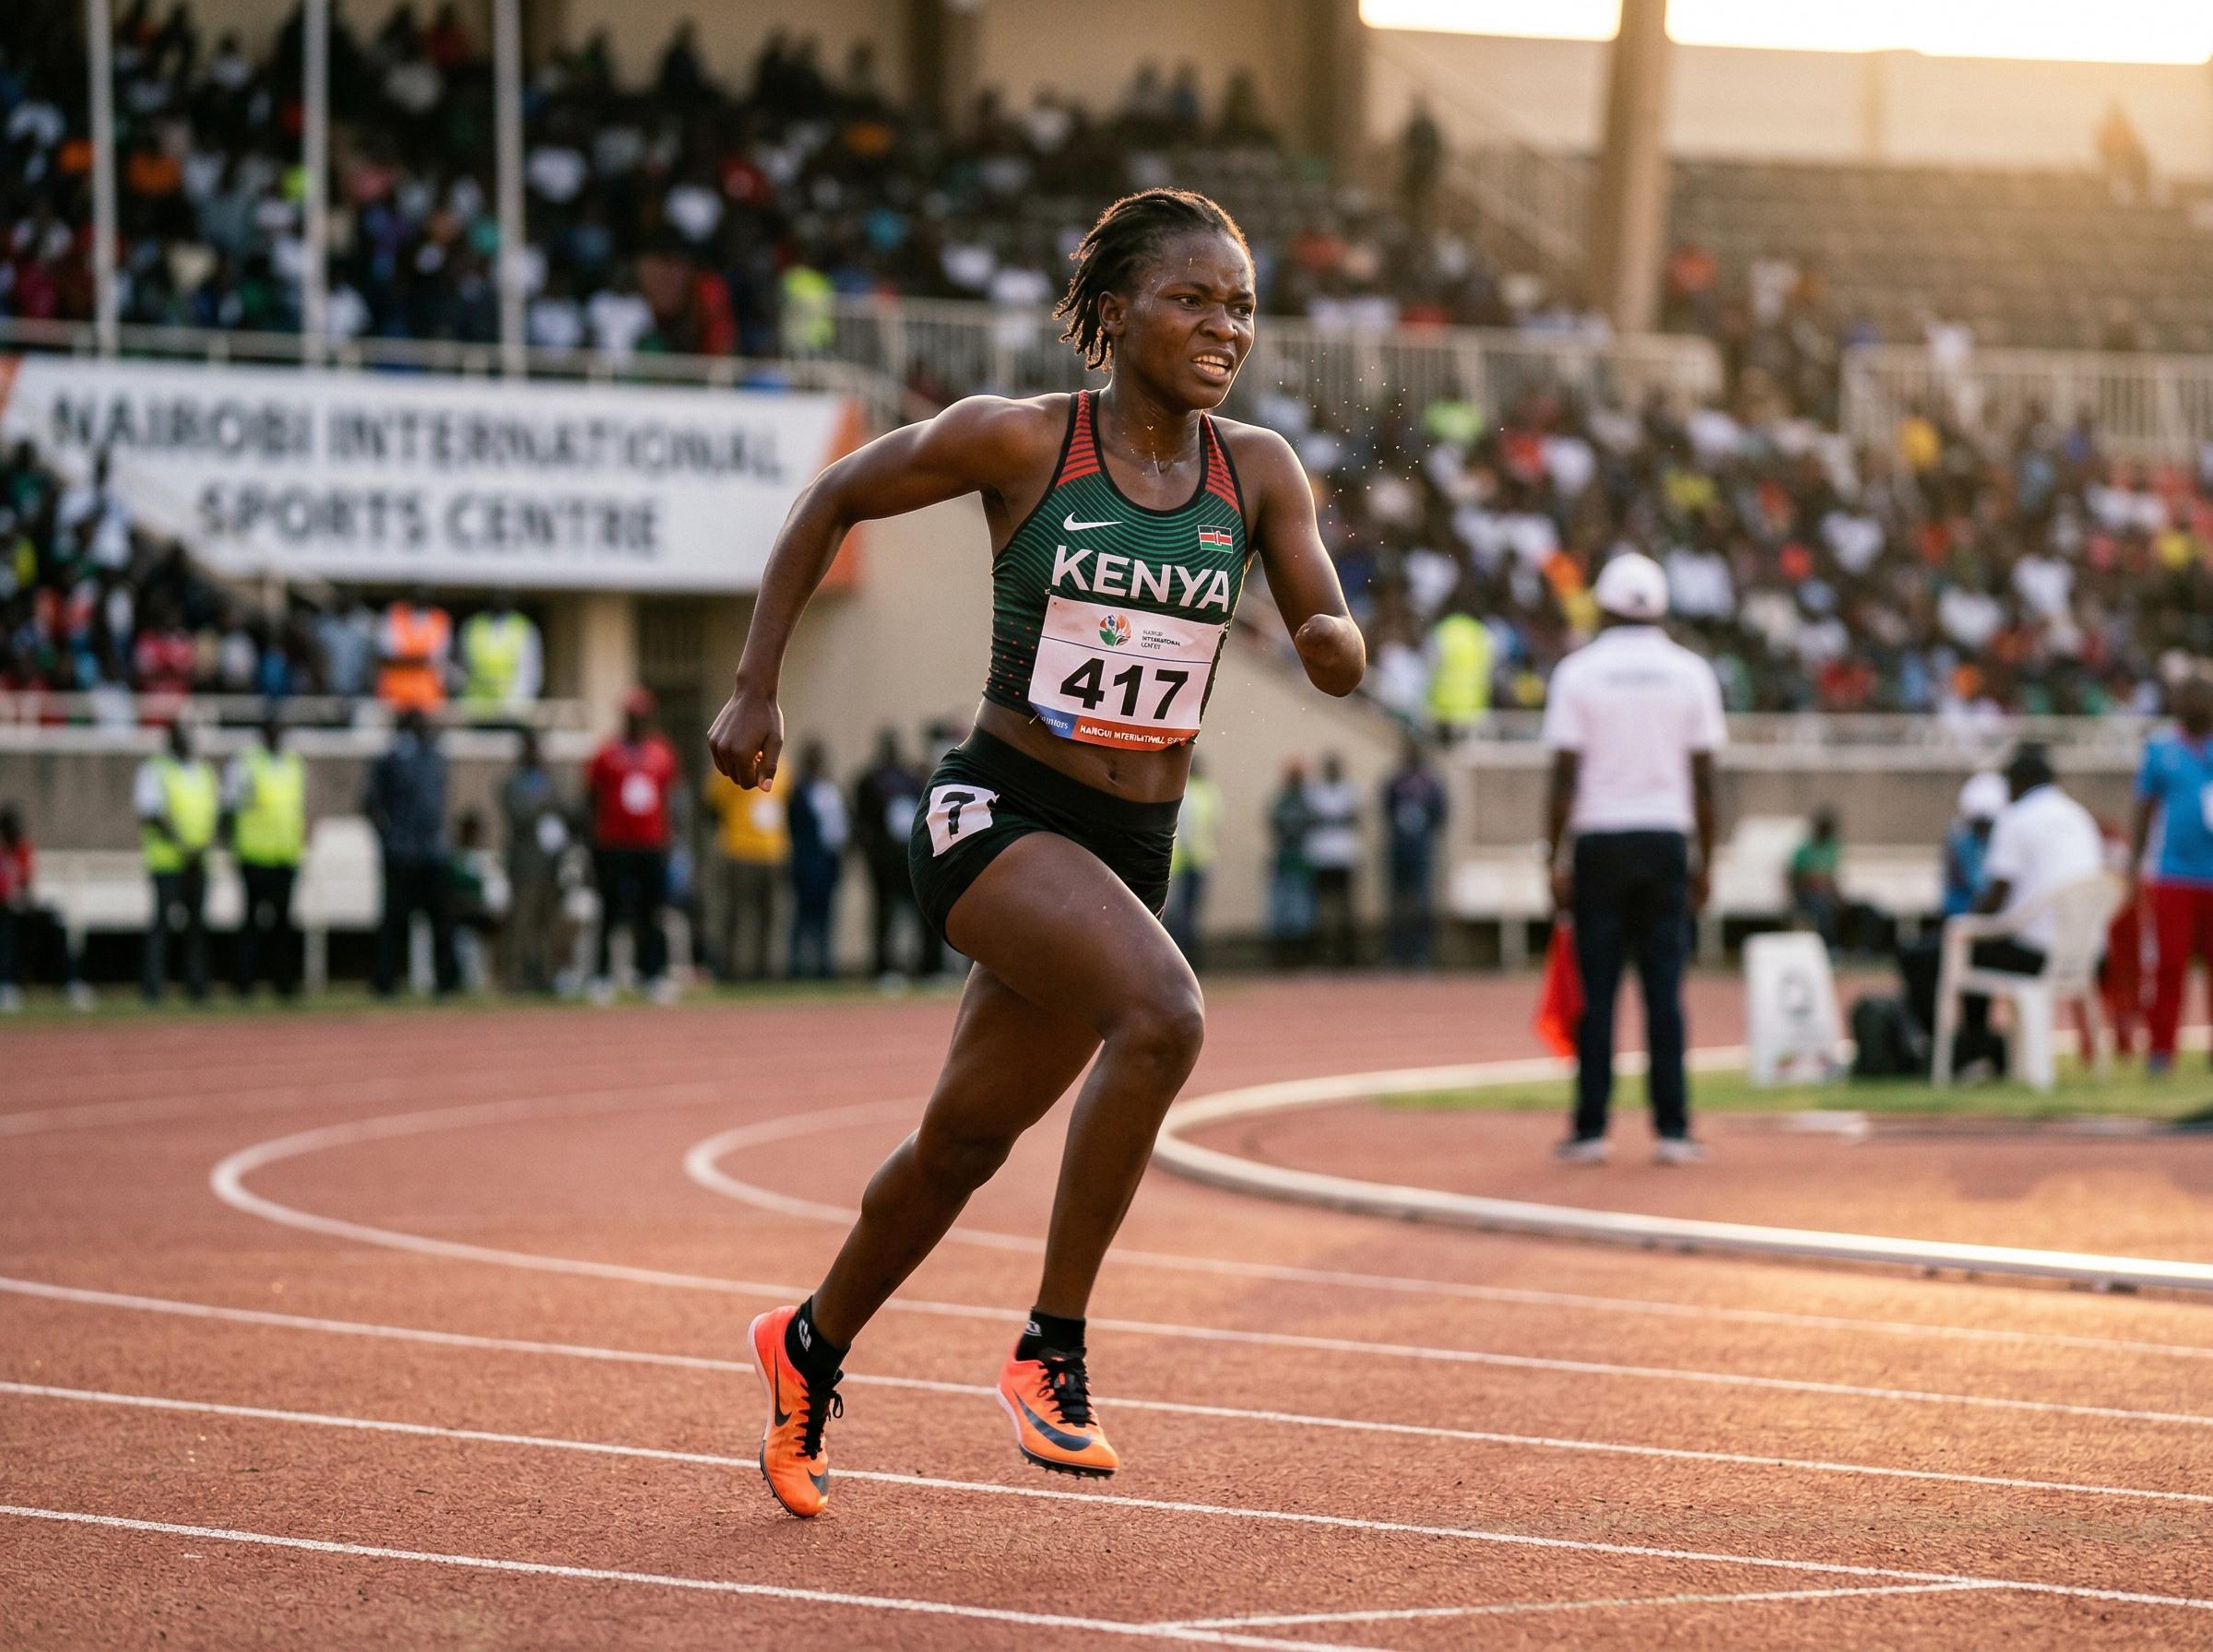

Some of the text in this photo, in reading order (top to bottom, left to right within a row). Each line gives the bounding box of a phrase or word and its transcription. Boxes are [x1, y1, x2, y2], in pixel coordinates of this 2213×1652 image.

[53, 391, 782, 482] NAIROBI INTERNATIONAL
[200, 480, 659, 557] SPORTS CENTRE
[1051, 545, 1229, 612] KENYA
[1059, 657, 1189, 720] 417
[941, 791, 976, 835] 7
